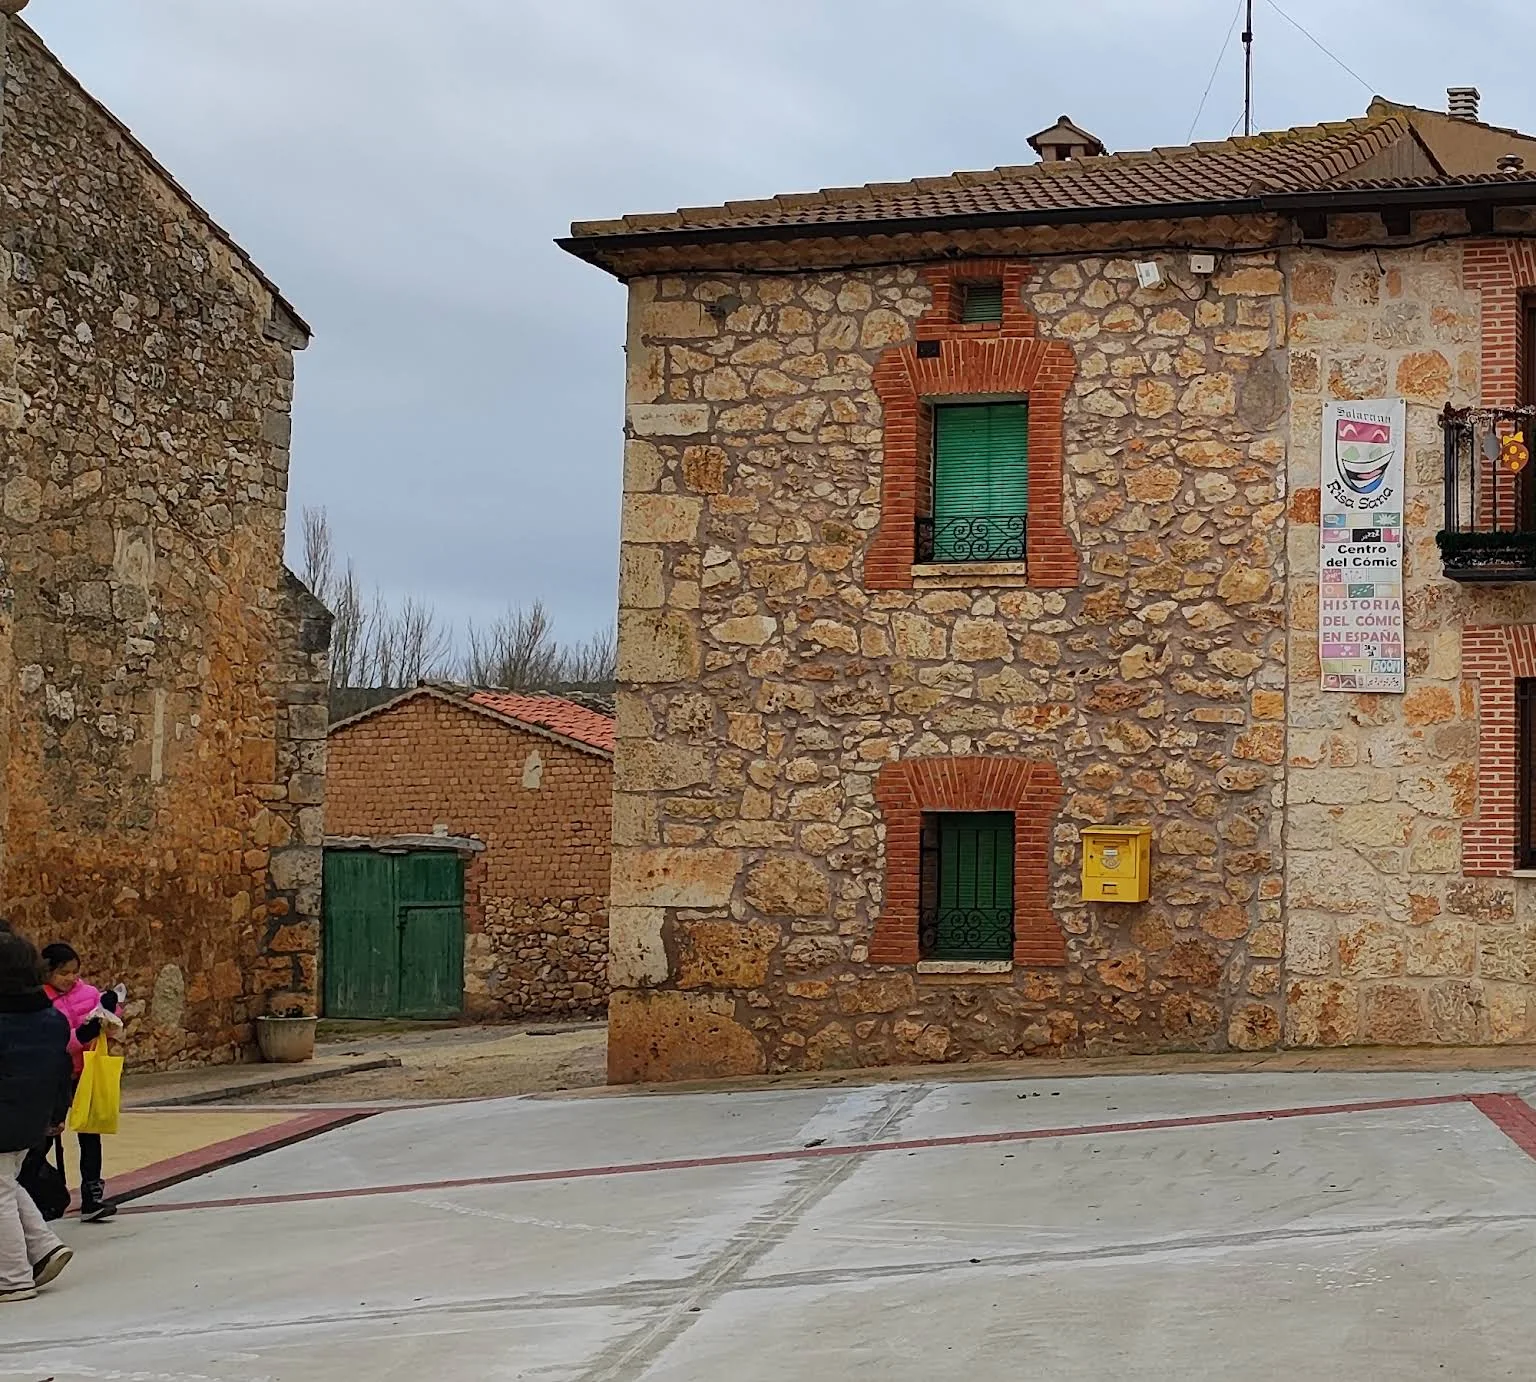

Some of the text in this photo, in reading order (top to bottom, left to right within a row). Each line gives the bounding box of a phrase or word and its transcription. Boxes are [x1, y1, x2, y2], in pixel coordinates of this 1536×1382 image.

[1326, 479, 1394, 510] Risa Sana
[1337, 544, 1387, 554] Centro
[1326, 557, 1398, 568] del Cómic
[1323, 600, 1401, 611] HISTORIA
[1322, 612, 1401, 627] DEL CÓMIC
[1322, 629, 1401, 643] EN ESPAÑA
